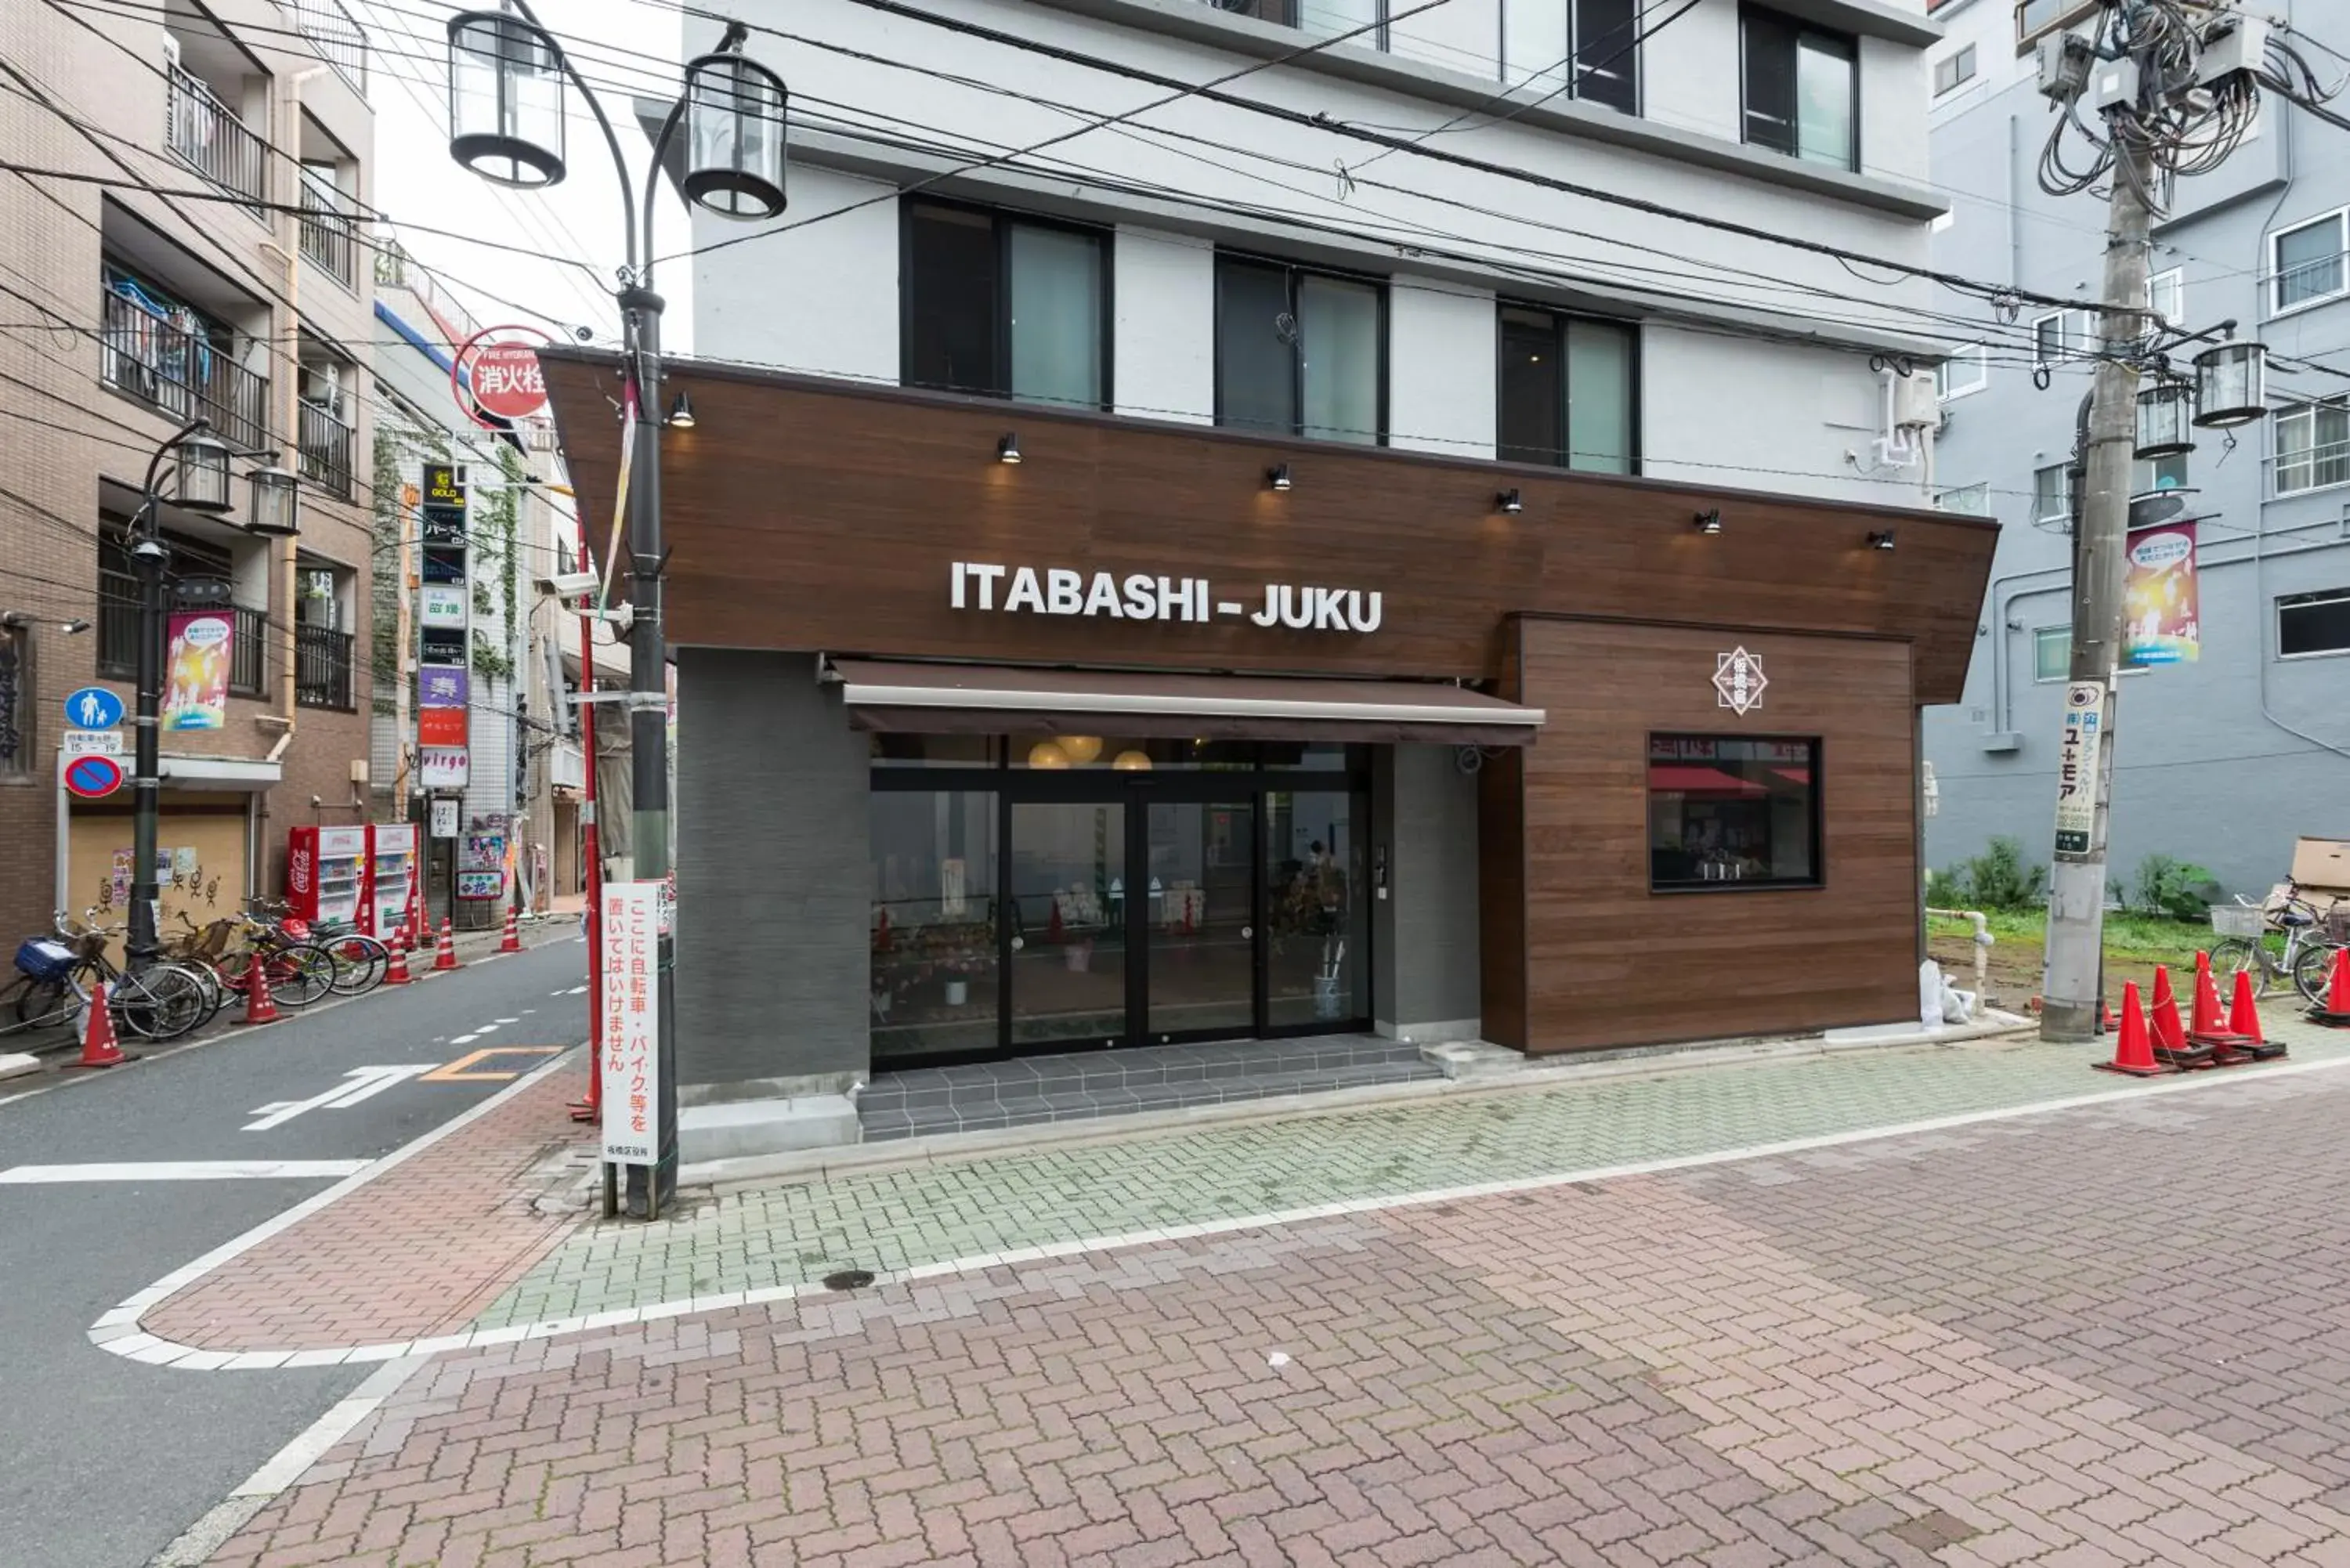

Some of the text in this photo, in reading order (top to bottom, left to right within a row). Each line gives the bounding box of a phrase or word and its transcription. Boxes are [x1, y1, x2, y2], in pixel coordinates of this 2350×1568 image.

[478, 363, 546, 394] 消火栓
[432, 488, 457, 497] GOLD
[424, 752, 467, 770] virgo
[608, 897, 624, 1072] 置いてはいけません
[629, 900, 648, 1133] ここに自転車・バイク等を
[607, 1144, 648, 1157] 板橋区役所
